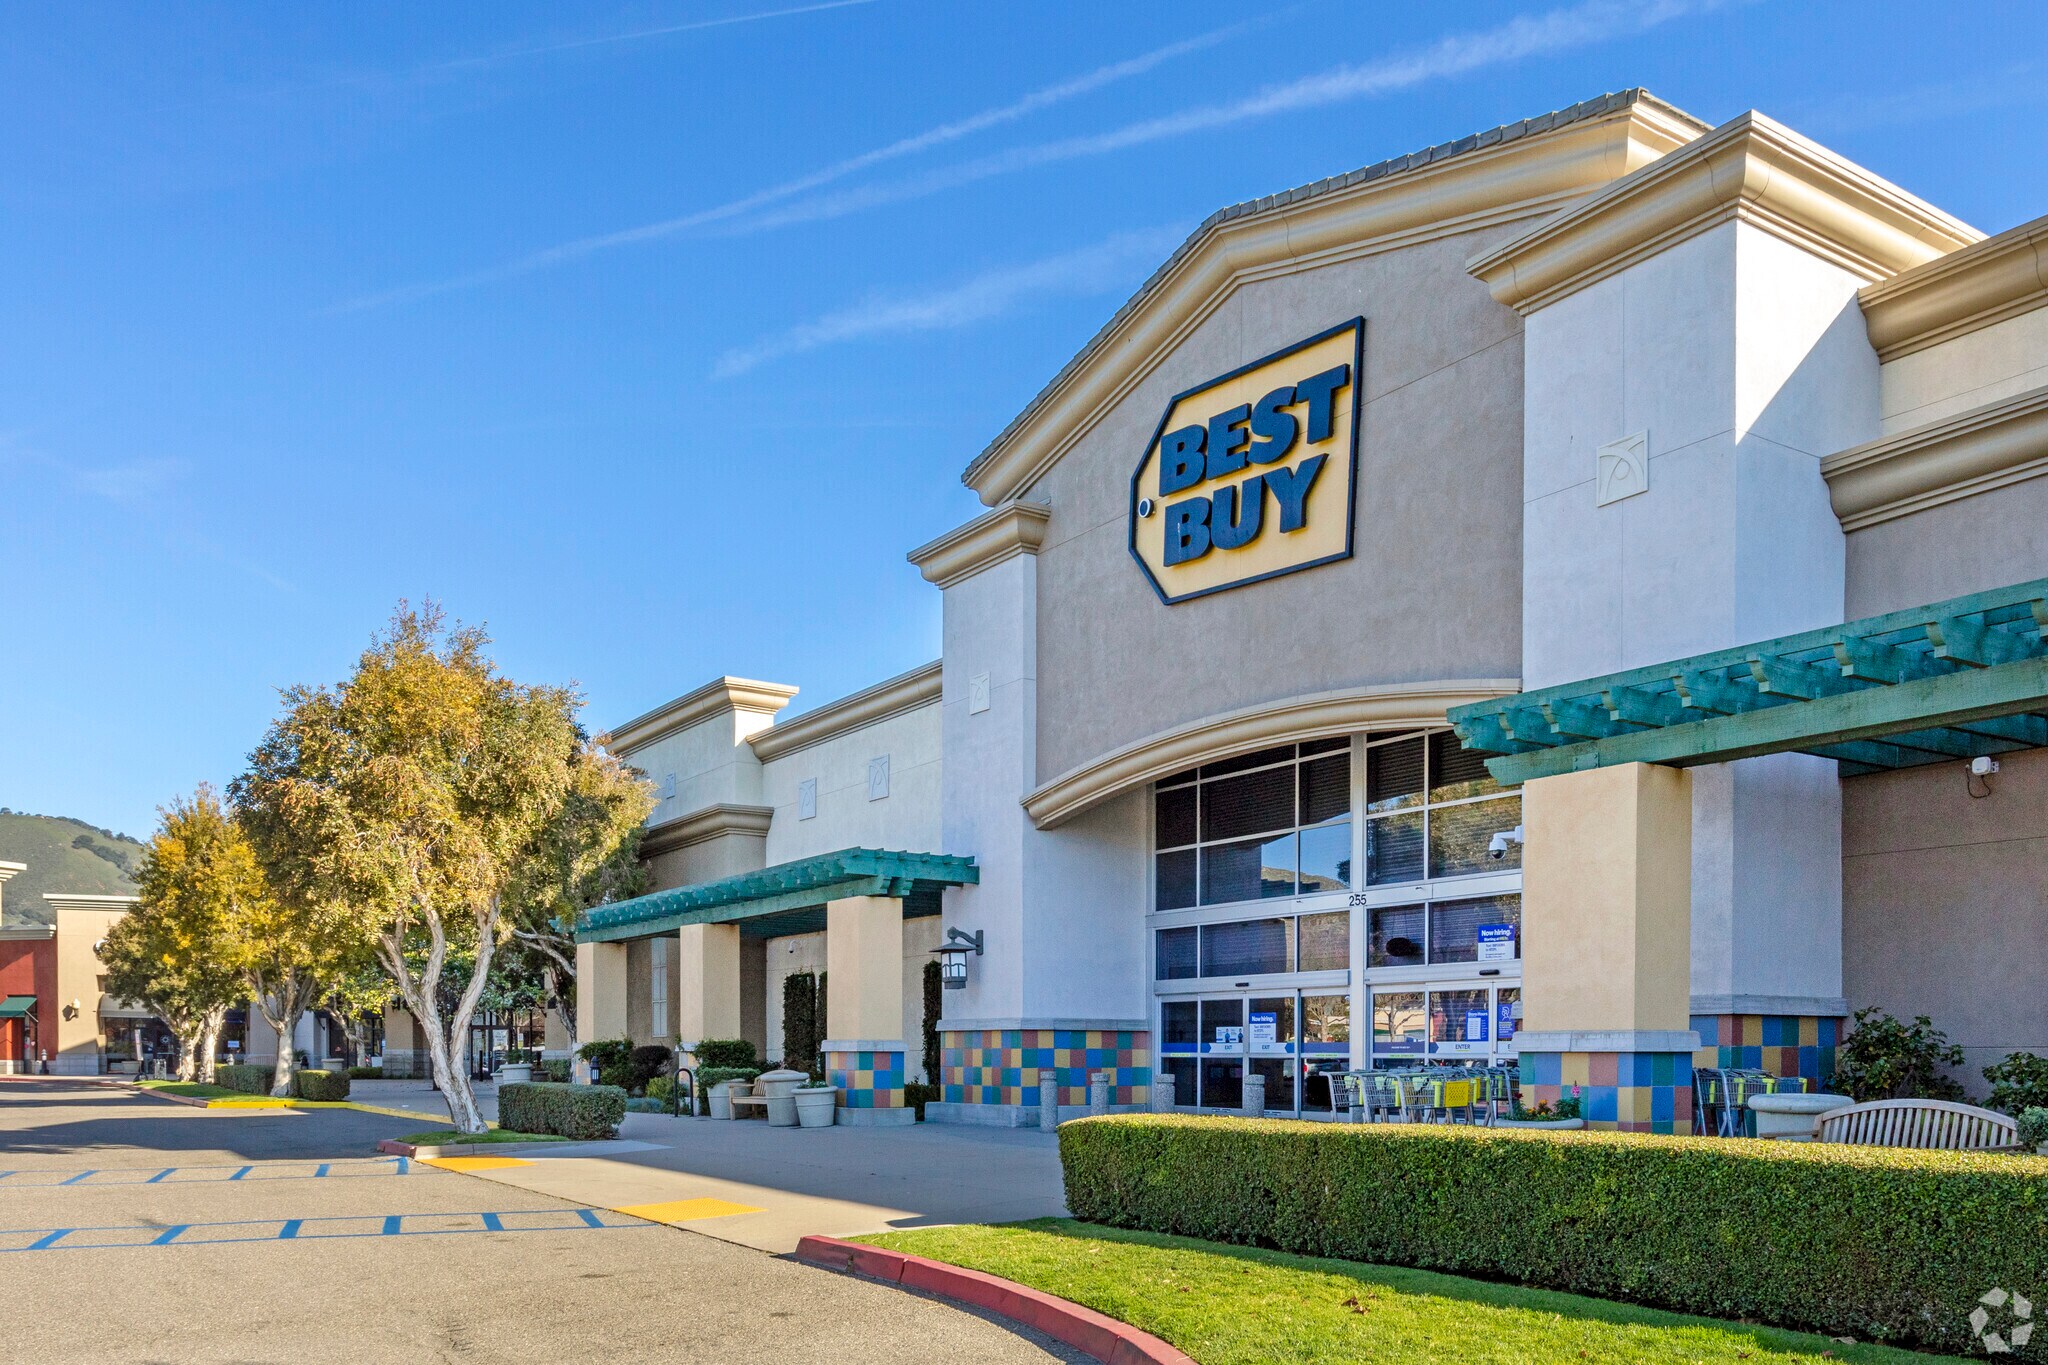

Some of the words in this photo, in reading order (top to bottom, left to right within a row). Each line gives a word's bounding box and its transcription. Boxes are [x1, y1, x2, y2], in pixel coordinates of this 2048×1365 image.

[1159, 363, 1350, 497] BEST
[1163, 453, 1329, 567] BUY
[1349, 894, 1366, 906] 255
